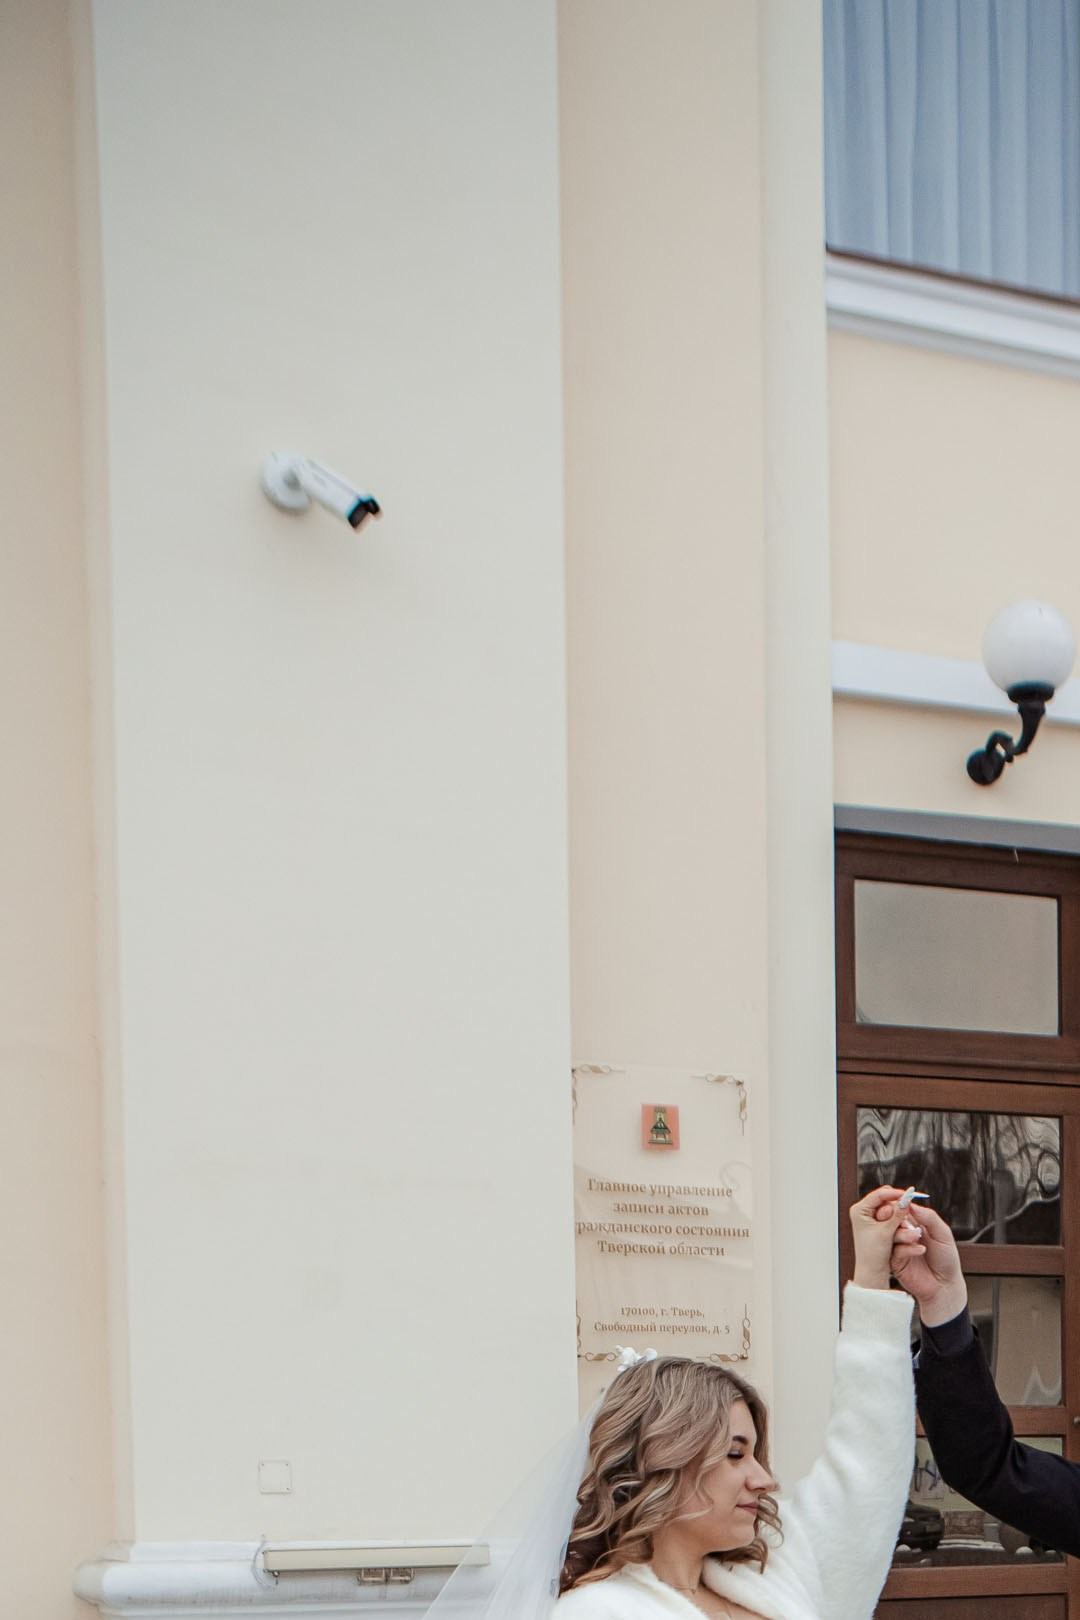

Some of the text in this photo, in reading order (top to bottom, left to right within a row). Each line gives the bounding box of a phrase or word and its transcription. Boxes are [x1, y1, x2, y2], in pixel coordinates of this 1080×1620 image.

[587, 1178, 733, 1198] Главное управление
[613, 1202, 709, 1216] записи актов
[675, 1224, 750, 1238] состояния
[597, 1239, 725, 1256] Тверской области
[660, 1308, 669, 1317] г.
[670, 1306, 705, 1319] Тверь,
[593, 1321, 730, 1335] Свободный переулок, д. 5
